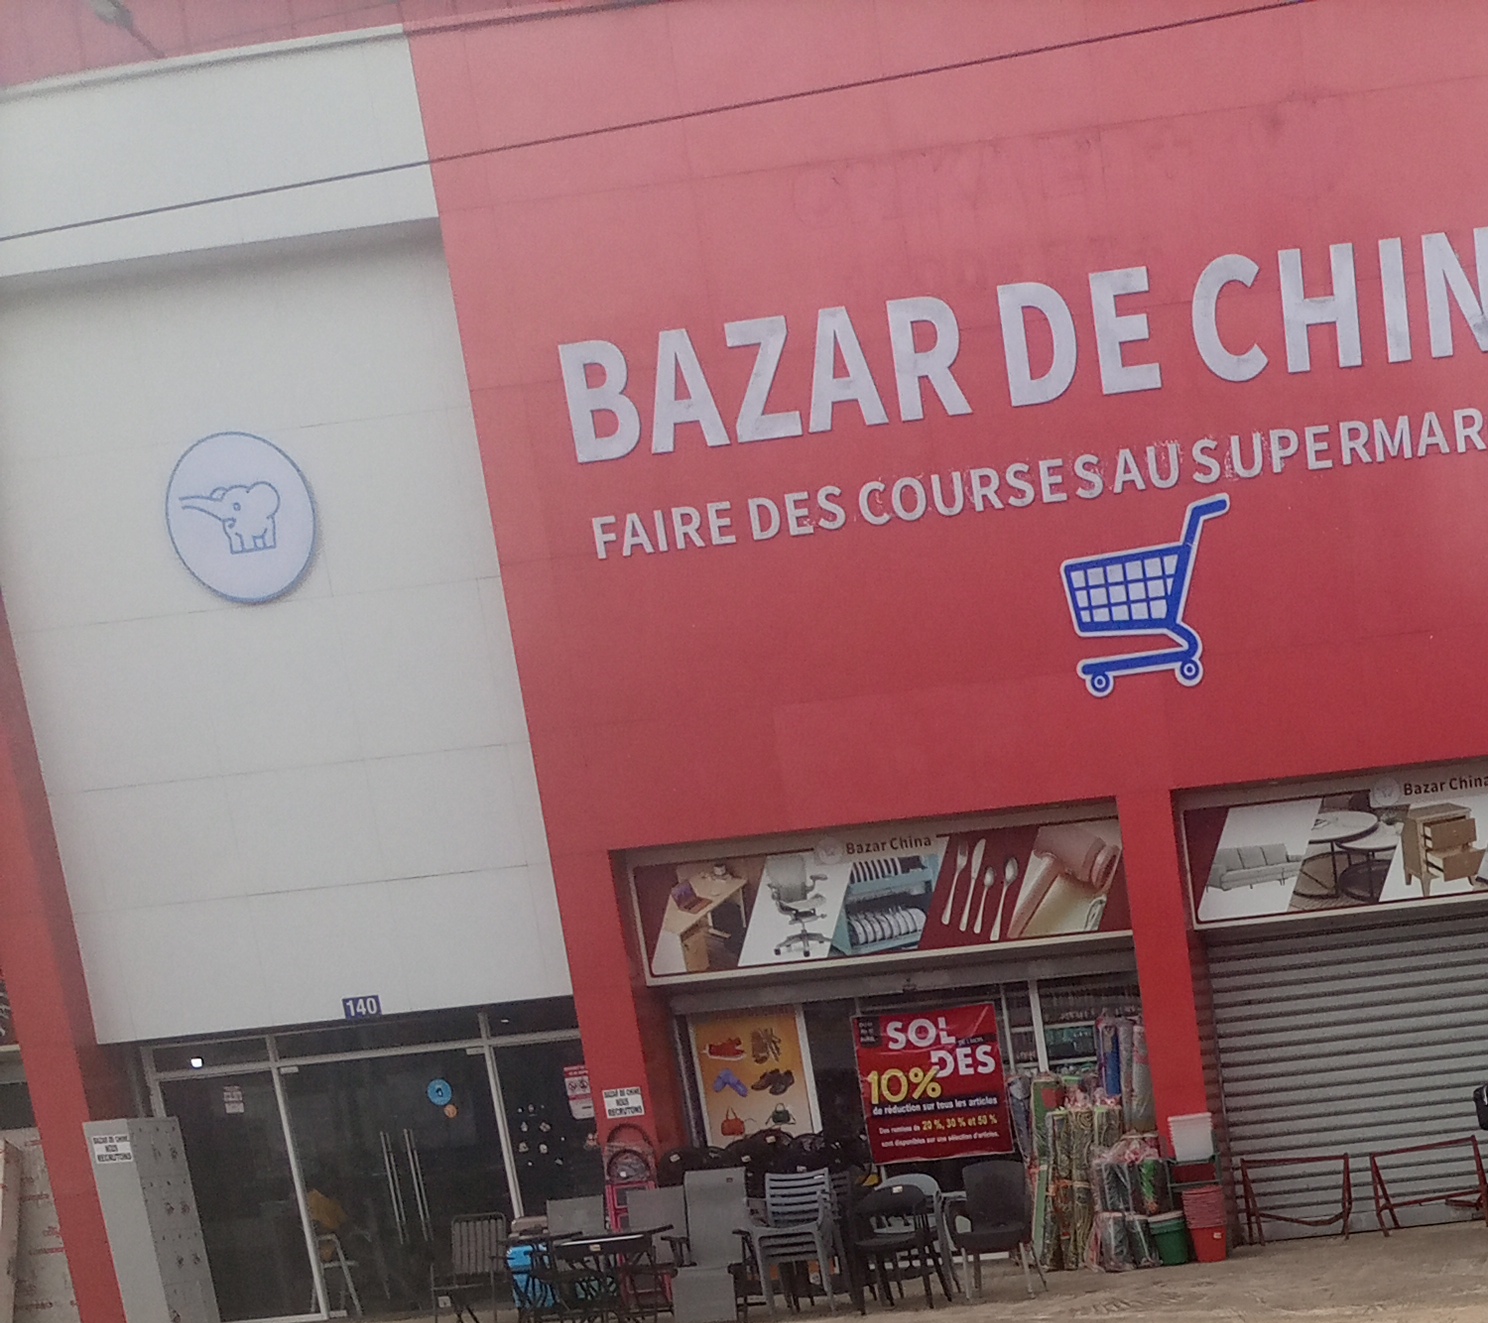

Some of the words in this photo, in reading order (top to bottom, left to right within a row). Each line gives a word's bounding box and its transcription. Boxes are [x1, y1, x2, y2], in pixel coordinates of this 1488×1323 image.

[557, 294, 974, 464] BAZAR
[996, 265, 1163, 408] DE
[592, 501, 737, 560] FAIRE
[747, 485, 847, 542] DES
[859, 453, 1106, 526] COURSES
[1112, 441, 1181, 495] AU
[1403, 780, 1446, 796] Bazar
[846, 841, 887, 855] Bazar
[890, 836, 932, 850] China
[346, 997, 378, 1017] 140
[886, 1017, 956, 1050] SOL
[930, 1045, 996, 1078] DES
[867, 1067, 942, 1105] 10%
[873, 1105, 883, 1116] de
[884, 1102, 921, 1116] réduction
[922, 1102, 935, 1111] sur
[936, 1100, 953, 1110] tous
[955, 1098, 967, 1108] les
[968, 1096, 998, 1107] articles
